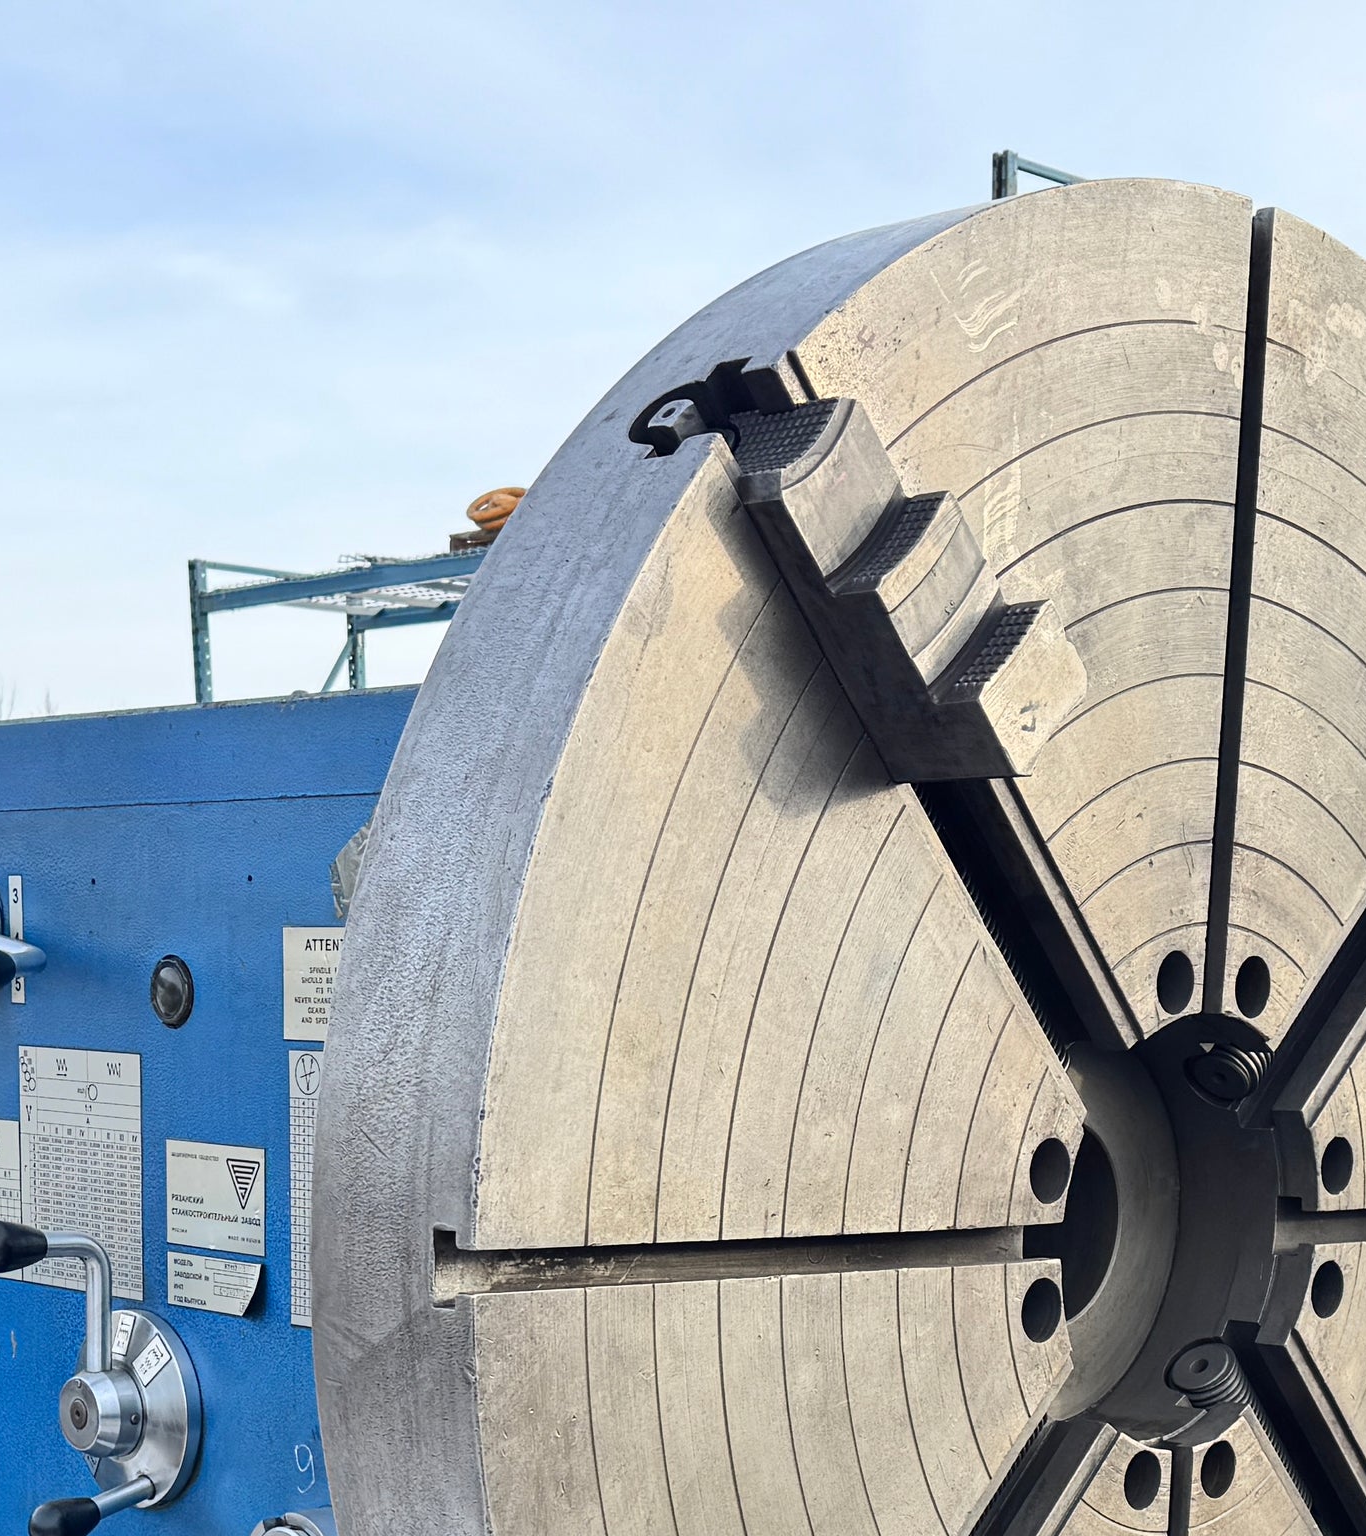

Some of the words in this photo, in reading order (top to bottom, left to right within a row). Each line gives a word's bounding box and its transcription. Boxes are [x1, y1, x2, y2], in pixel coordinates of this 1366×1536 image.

[12, 887, 19, 904] 3
[304, 938, 344, 952] ATTEN
[15, 976, 22, 992] 5
[307, 1007, 326, 1015] GEARS
[301, 1016, 313, 1024] AND
